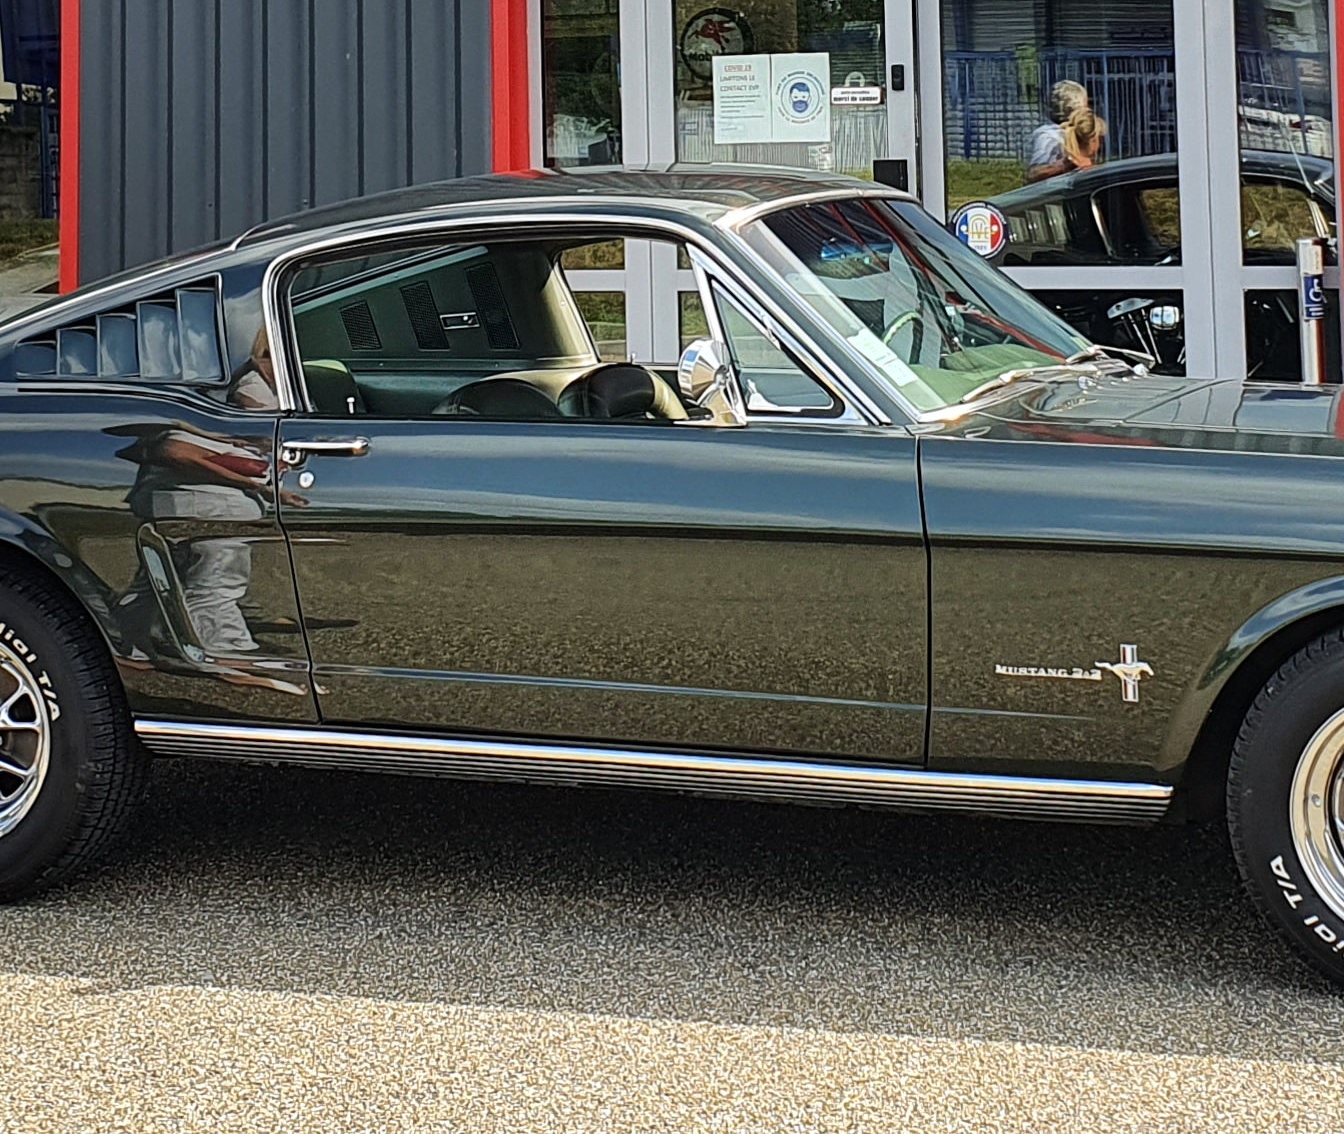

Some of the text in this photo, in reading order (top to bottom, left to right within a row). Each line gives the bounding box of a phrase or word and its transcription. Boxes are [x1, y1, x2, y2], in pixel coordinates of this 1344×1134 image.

[38, 670, 61, 722] T/A
[994, 663, 1069, 678] MUSTANG
[1270, 855, 1304, 910] T/A
